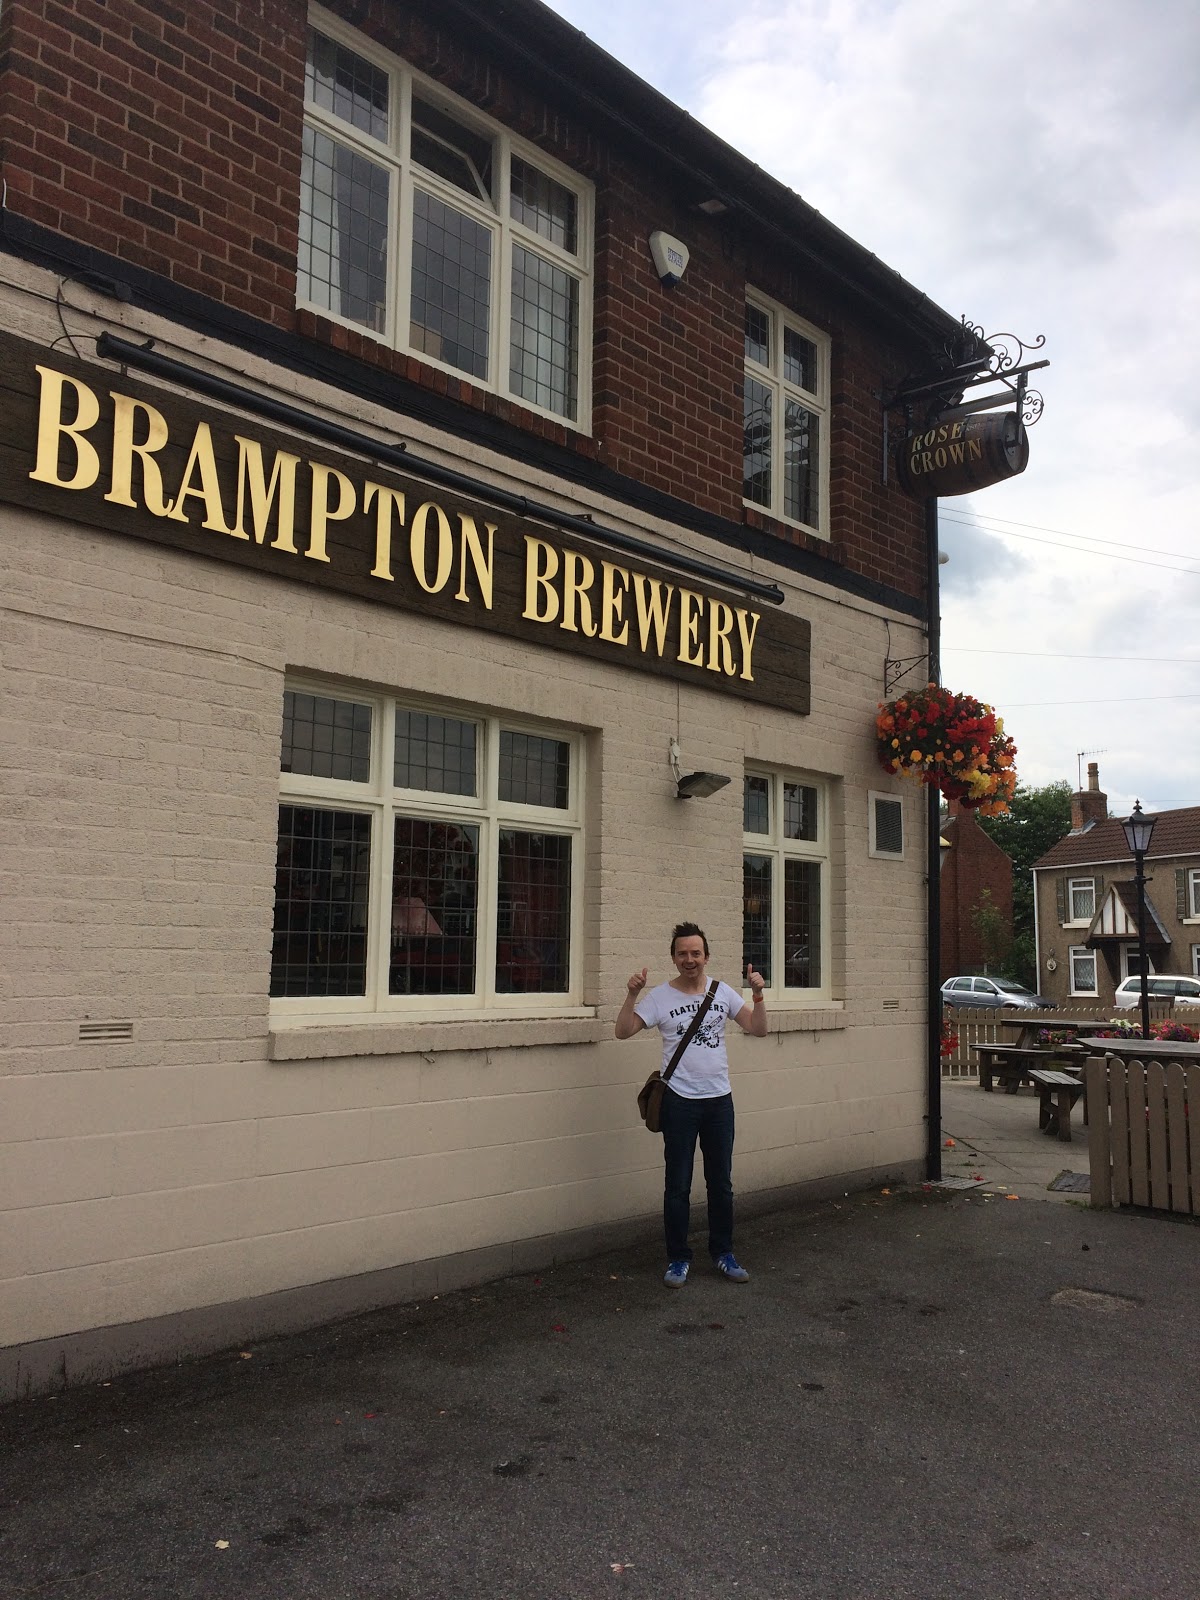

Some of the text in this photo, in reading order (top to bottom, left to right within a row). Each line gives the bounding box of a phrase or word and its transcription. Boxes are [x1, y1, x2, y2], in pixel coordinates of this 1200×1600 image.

[911, 421, 964, 453] ROSE
[910, 437, 983, 475] CROWN
[29, 364, 760, 682] BRAMPTON BREWERY
[669, 1003, 725, 1018] FLATLIERS
